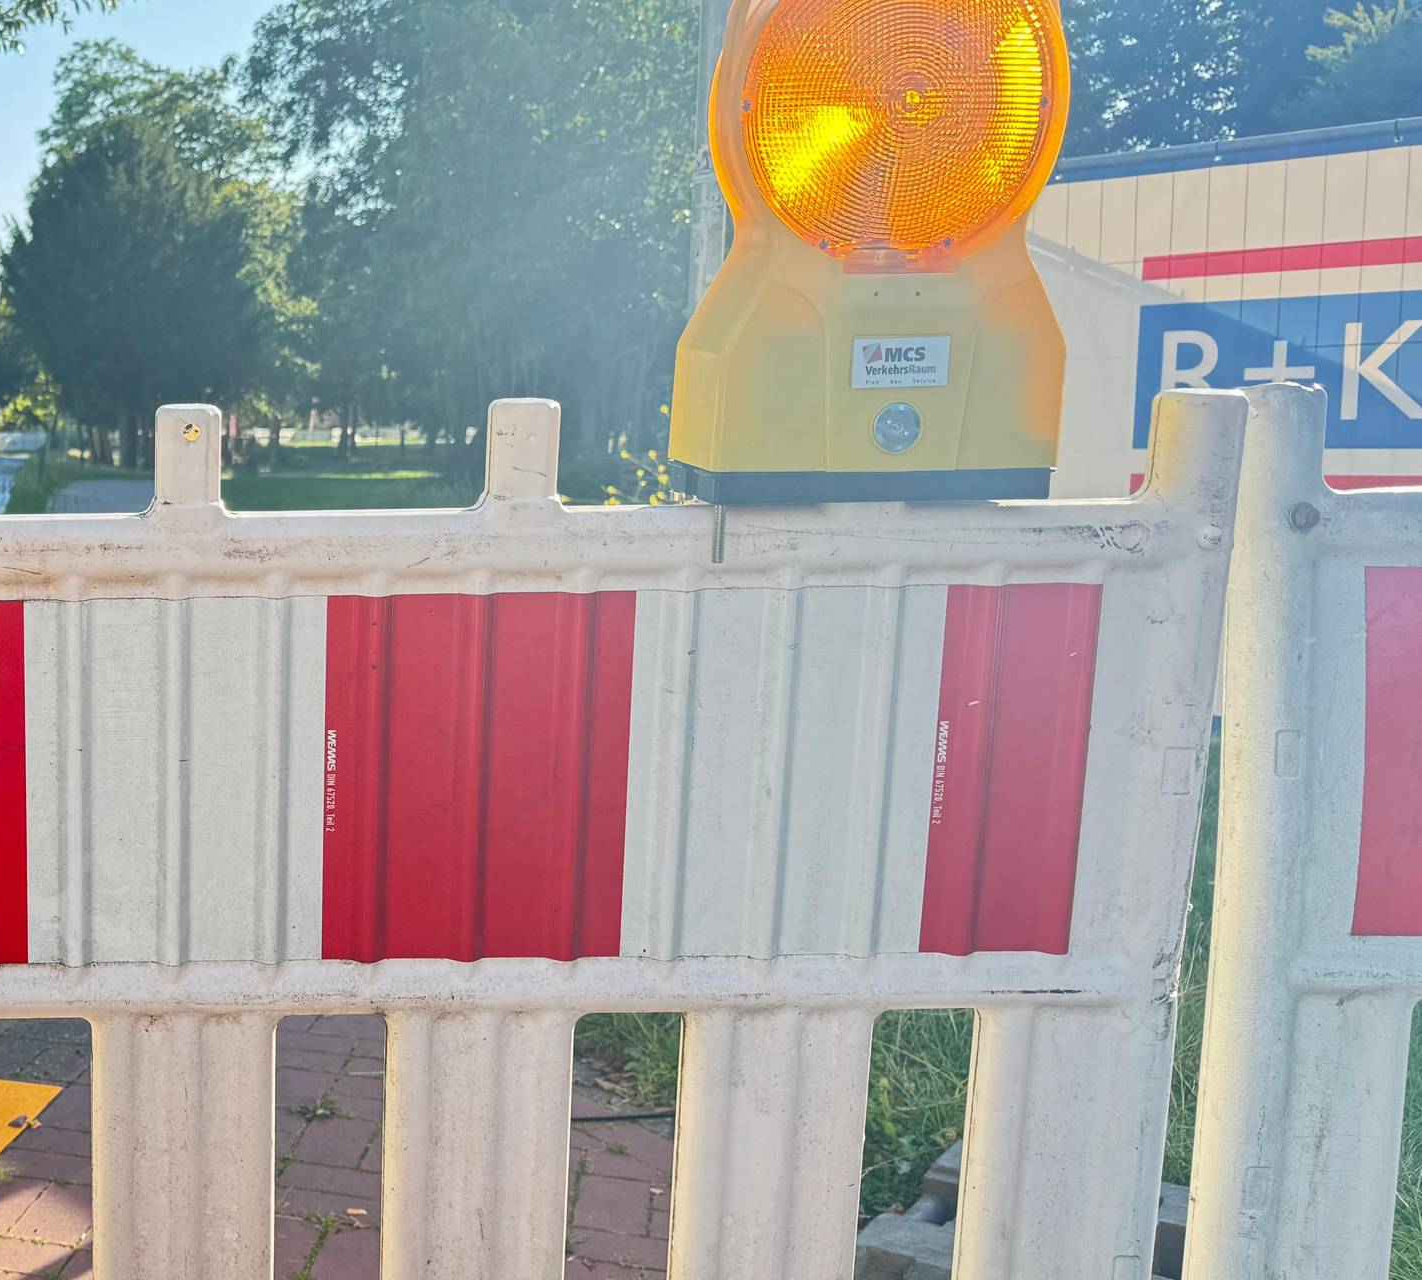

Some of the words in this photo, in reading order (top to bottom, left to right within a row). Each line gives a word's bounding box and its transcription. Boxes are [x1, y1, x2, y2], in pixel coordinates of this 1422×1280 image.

[885, 346, 926, 362] MCS
[866, 365, 936, 376] VerkehrsRaum
[936, 766, 946, 778] DIN
[327, 774, 335, 786] DIN
[327, 813, 335, 825] Teil
